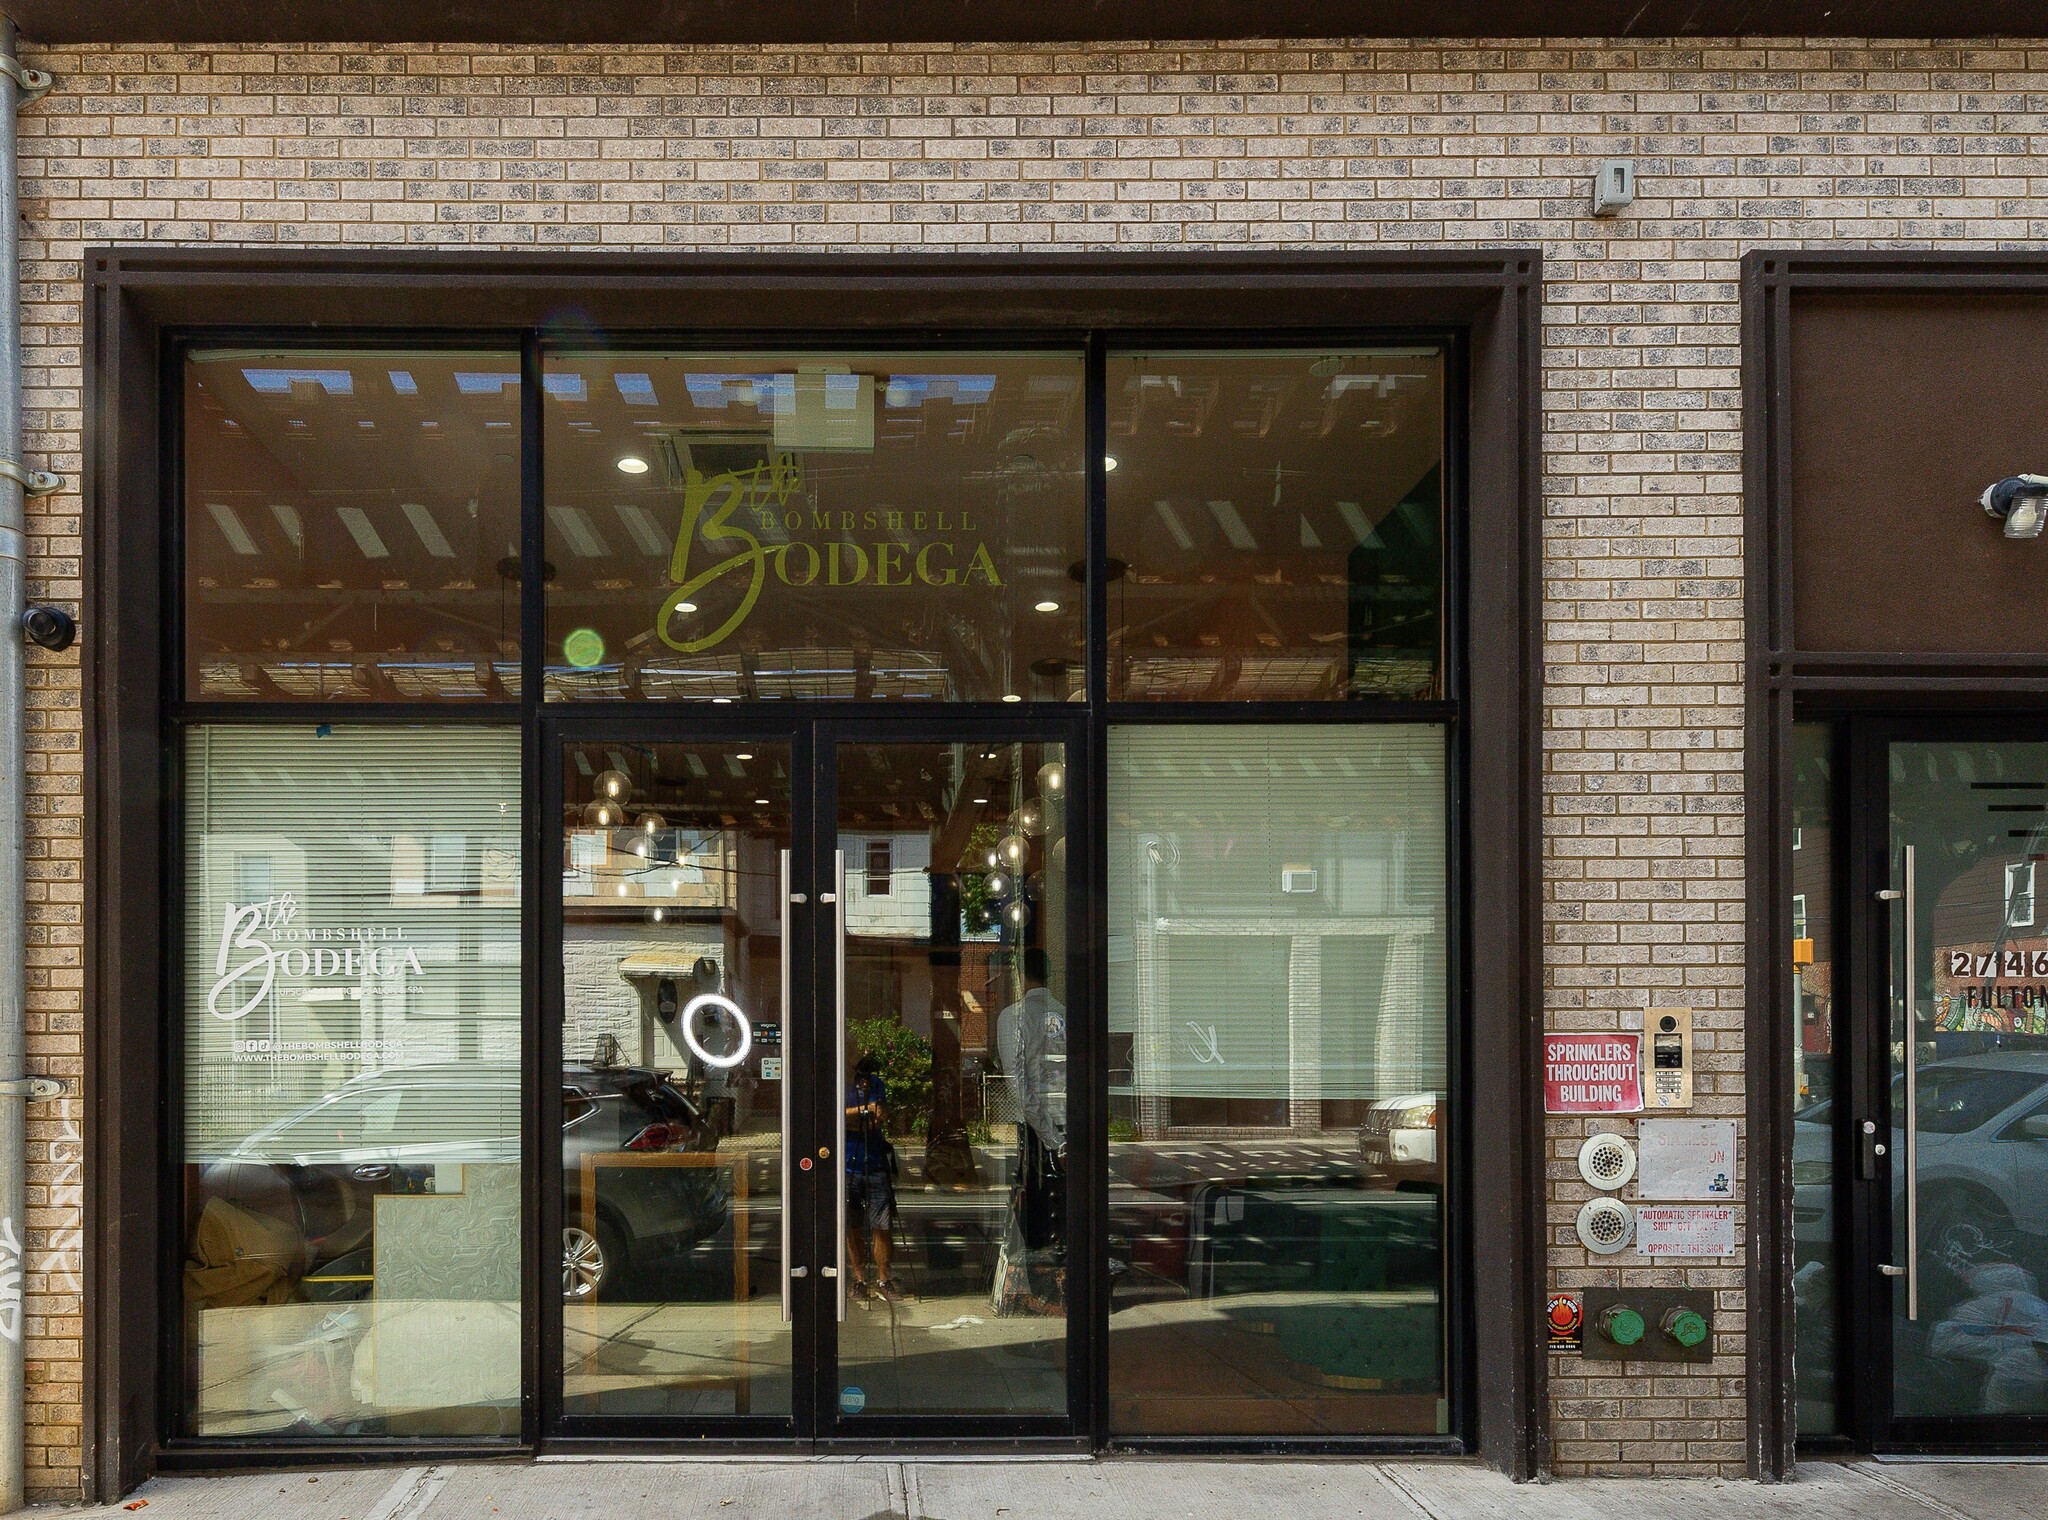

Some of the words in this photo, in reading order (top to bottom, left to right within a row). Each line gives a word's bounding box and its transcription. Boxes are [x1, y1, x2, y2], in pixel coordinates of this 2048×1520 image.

[760, 511, 978, 532] BOMBSHELL
[251, 891, 301, 931] the
[271, 927, 409, 942] BOMBSHELL
[1953, 952, 2048, 976] 2746
[407, 985, 424, 994] SPA
[1967, 985, 2048, 1009] FULTON
[233, 1052, 404, 1062] WWW.THEBOMBSHELLBODEGA.COM
[1547, 1043, 1631, 1062] SPRINKLERS
[1546, 1063, 1635, 1082] THROUGHOUT
[1560, 1084, 1622, 1103] BUILDING
[1643, 1210, 1685, 1220] AUTOMATIC
[1687, 1210, 1728, 1220] SPRINKLER
[1653, 1221, 1674, 1231] SHUT
[1648, 1243, 1685, 1253] OPPOSITE
[1687, 1243, 1704, 1253] THIS
[1706, 1243, 1724, 1253] SIGN
